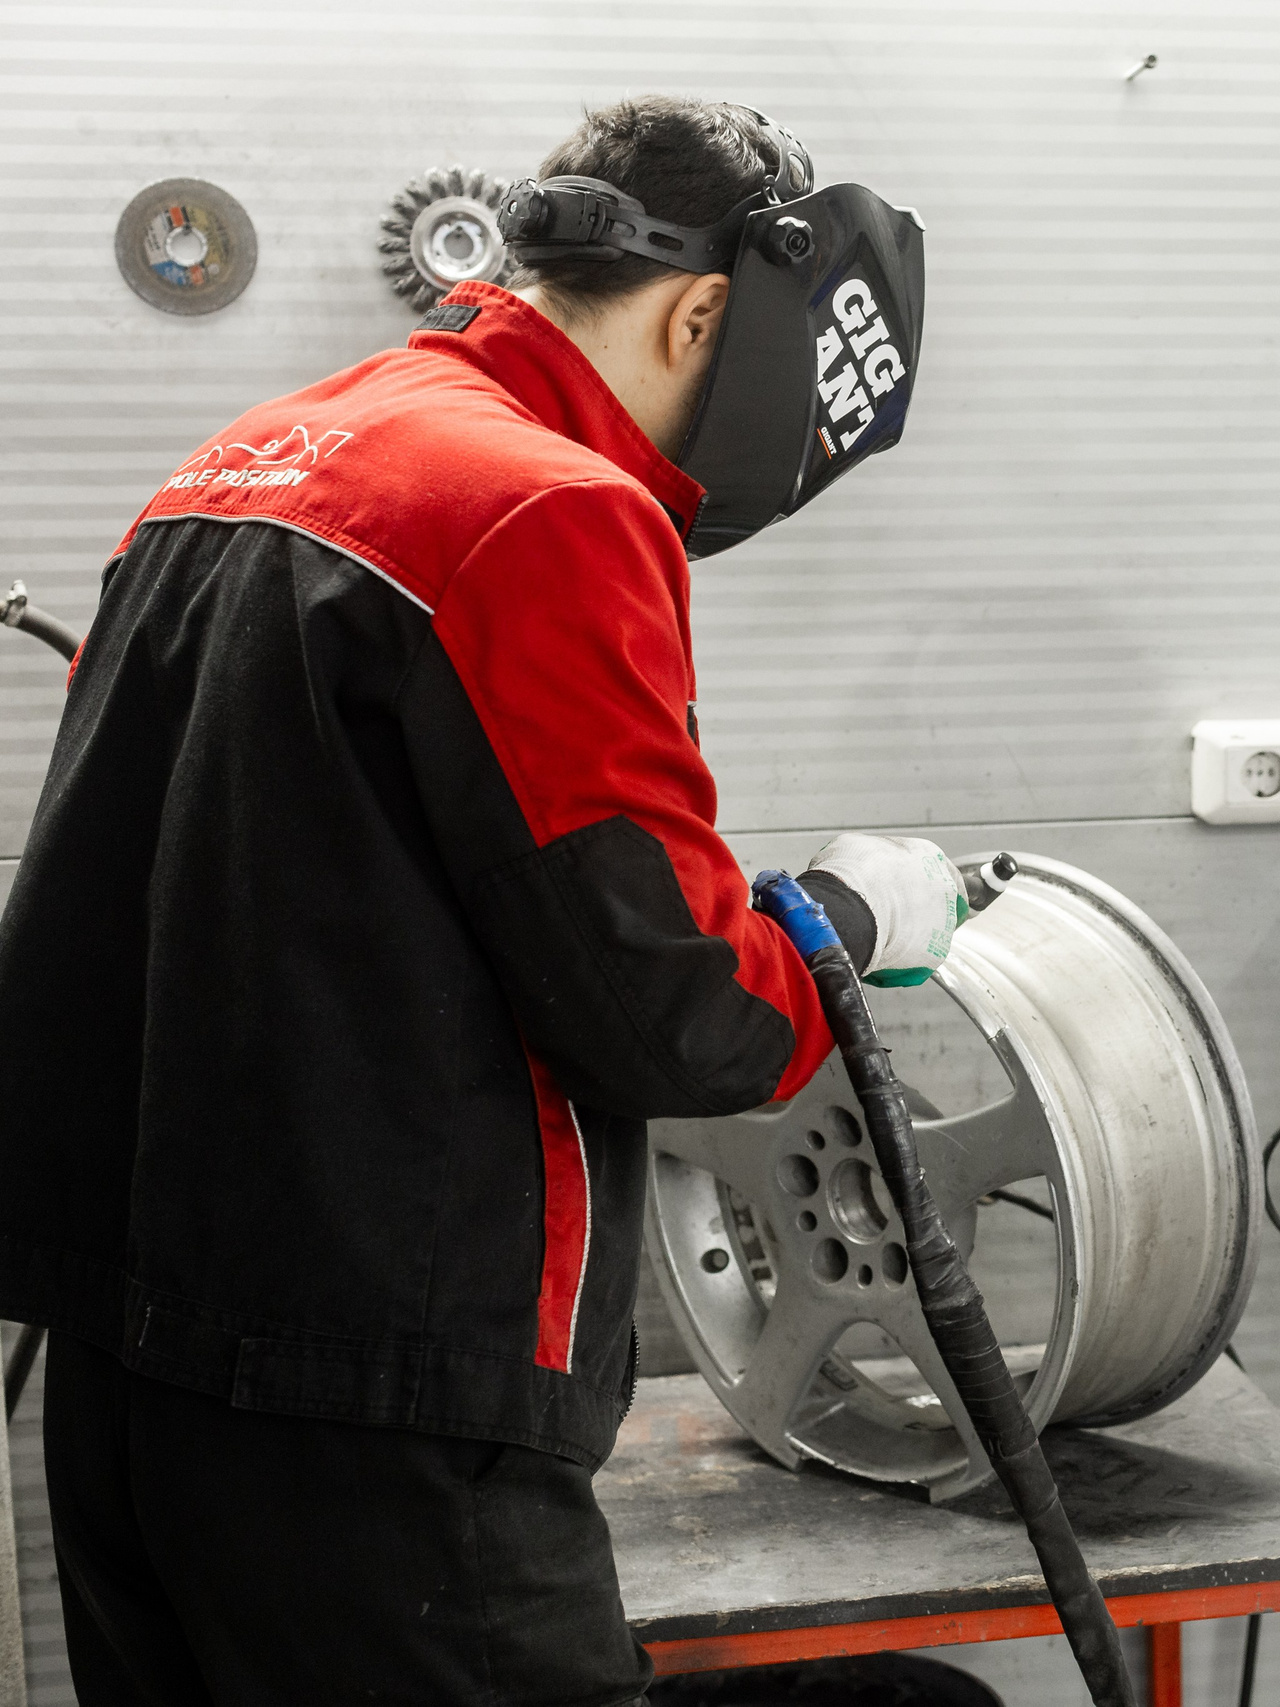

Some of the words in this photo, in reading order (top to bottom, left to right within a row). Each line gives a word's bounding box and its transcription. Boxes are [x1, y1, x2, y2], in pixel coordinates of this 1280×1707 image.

[833, 279, 906, 398] GIG
[821, 427, 837, 455] GIGANT
[162, 469, 217, 493] POLE
[212, 468, 310, 487] POSITION
